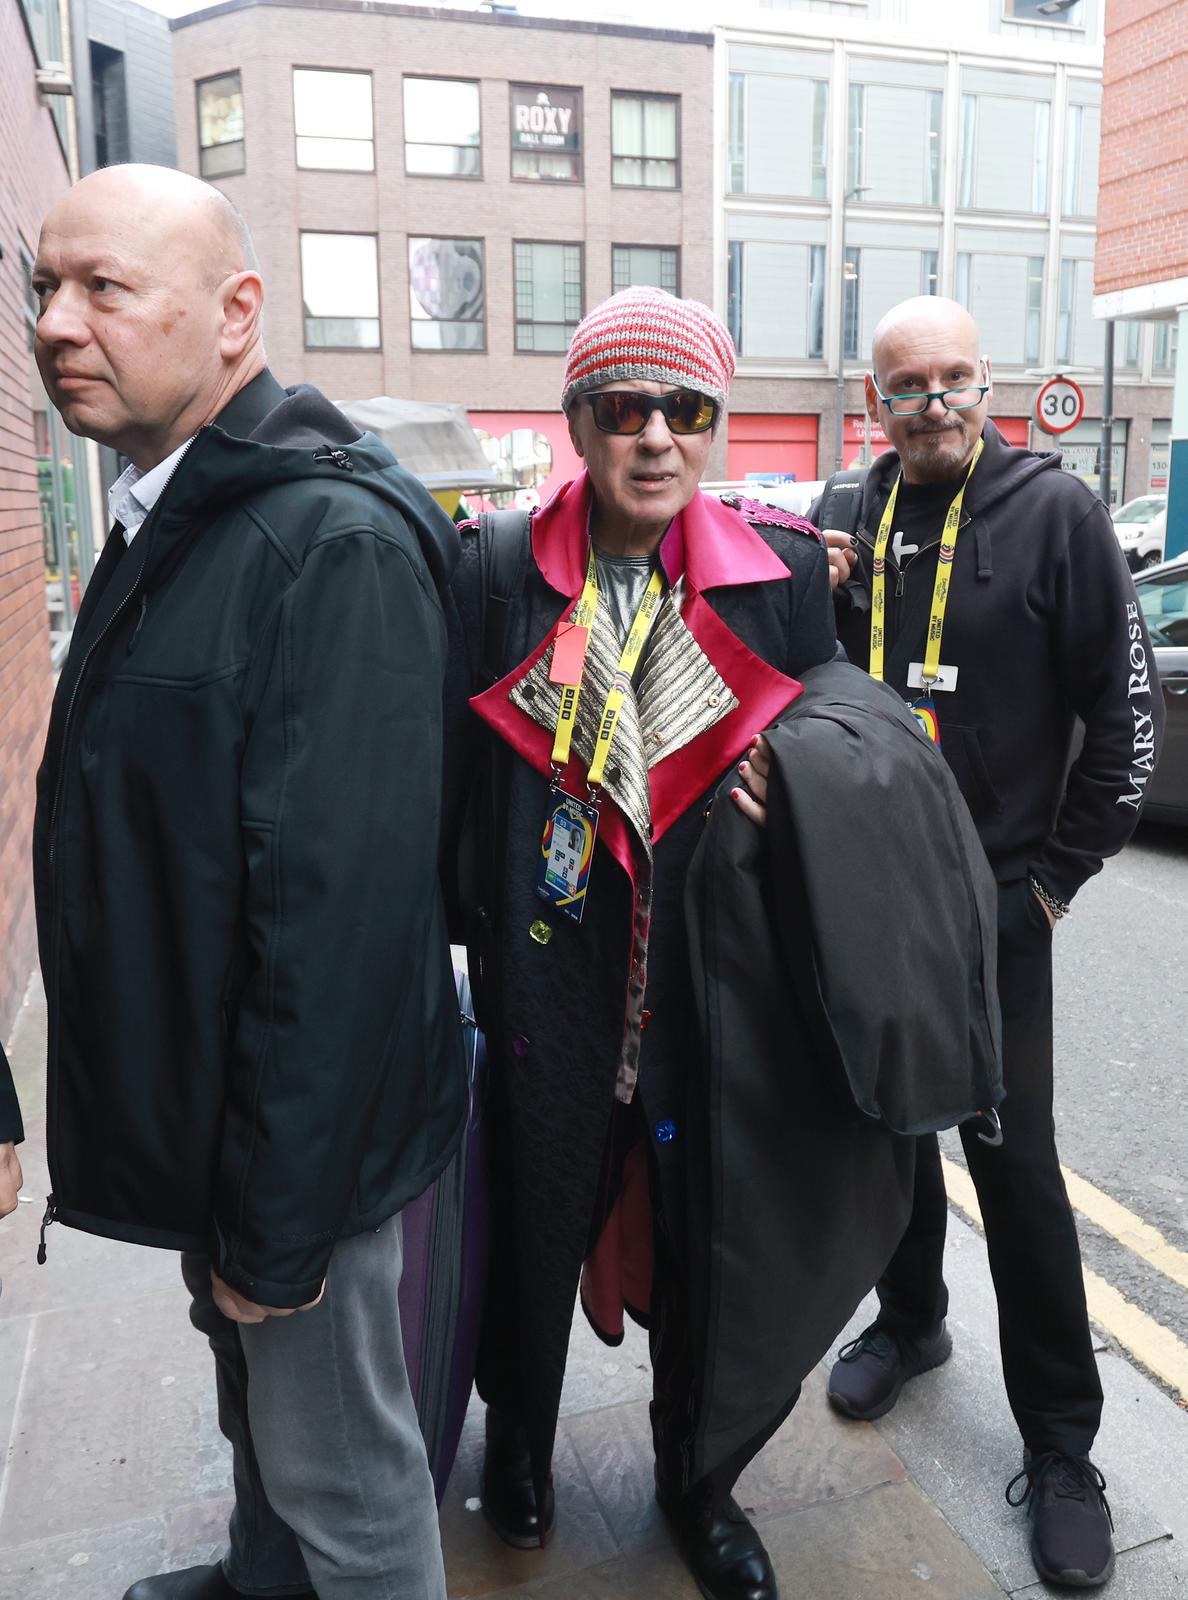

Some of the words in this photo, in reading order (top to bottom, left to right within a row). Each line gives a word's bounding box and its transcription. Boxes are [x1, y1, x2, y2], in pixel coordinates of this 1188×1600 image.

[515, 104, 572, 134] ROXY
[1044, 395, 1077, 416] 30
[640, 590, 652, 613] UNITED
[645, 609, 651, 618] BY
[649, 591, 658, 609] MUSIC
[1125, 600, 1152, 699] ROSE
[600, 709, 616, 740] BBC
[1115, 705, 1155, 812] MARY
